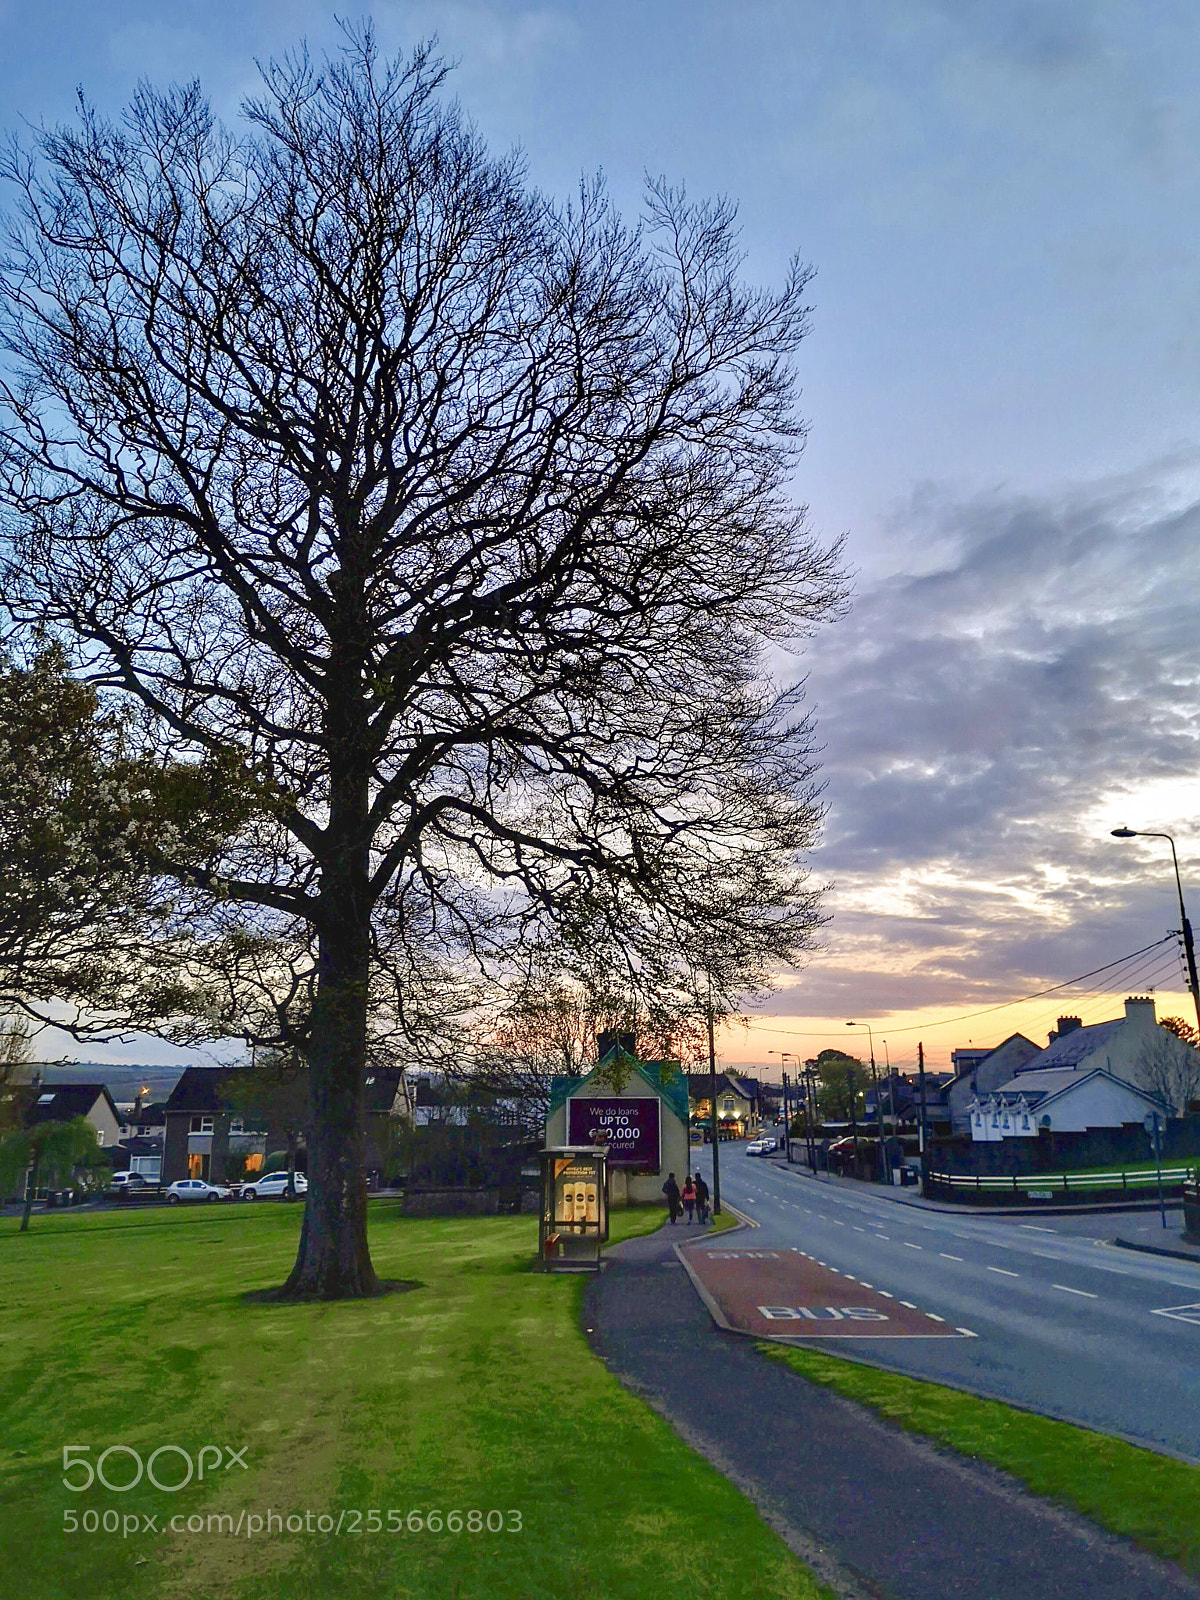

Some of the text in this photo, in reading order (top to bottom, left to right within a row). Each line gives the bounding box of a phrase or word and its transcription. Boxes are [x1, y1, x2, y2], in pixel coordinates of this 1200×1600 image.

[589, 1107, 639, 1116] We do loans
[600, 1116, 629, 1125] UP TO
[588, 1128, 640, 1140] €0,000
[757, 1306, 890, 1321] BUS
